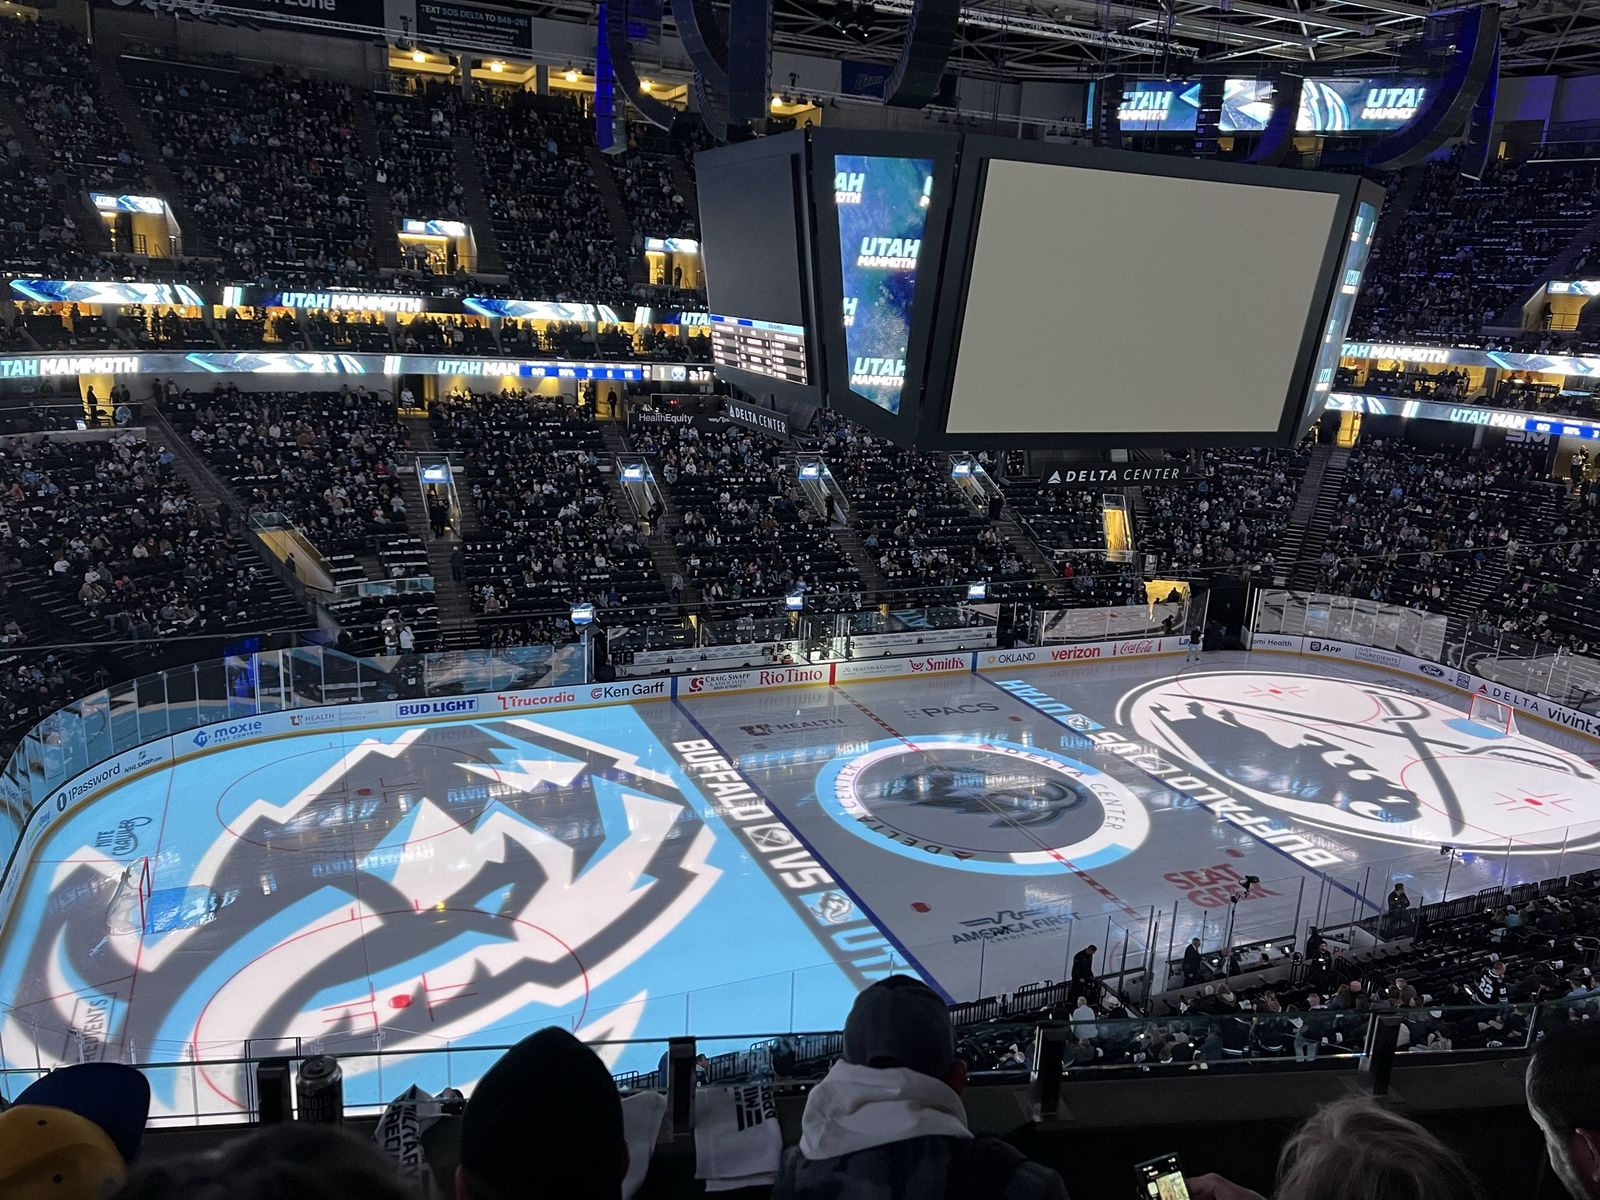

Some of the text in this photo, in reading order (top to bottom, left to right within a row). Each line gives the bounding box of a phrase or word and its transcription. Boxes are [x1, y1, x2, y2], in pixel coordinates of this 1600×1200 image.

[441, 7, 460, 17] SOS
[460, 9, 484, 21] DELTA
[484, 13, 496, 22] TO
[860, 236, 921, 258] UTAH
[857, 255, 917, 269] MAMMOTH
[281, 292, 422, 312] UTAH MAMMOTH
[680, 311, 711, 326] UTA
[1341, 344, 1449, 362] TAH MAMMOTH
[0, 356, 139, 377] TAH MAMMOTH
[437, 360, 482, 375] UTAH
[638, 413, 694, 424] HealthEquity
[735, 408, 787, 434] DELTA CENTER
[1450, 409, 1490, 424] UTAH
[1065, 468, 1180, 482] DELTA CENTER
[1268, 639, 1292, 648] Health
[998, 652, 1036, 663] OKLAND
[1052, 646, 1100, 660] verizon
[1358, 651, 1398, 663] INGREDIENTS
[926, 657, 964, 672] Smith's
[604, 682, 664, 698] Ken Garff
[994, 679, 1073, 715] UTAH
[510, 691, 575, 707] Trucordia
[1493, 687, 1539, 712] DELTA
[400, 700, 476, 716] BUD LIGHT
[920, 702, 1000, 717] PACS
[305, 713, 334, 721] HEALTH
[776, 719, 845, 730] HEALTH
[215, 721, 262, 738] moxie
[68, 763, 120, 800] 1Password
[673, 738, 775, 821] BUFFALO
[1089, 783, 1126, 833] CENTER
[1172, 776, 1344, 867] BUFFALO
[769, 851, 835, 889] VS
[1163, 863, 1246, 890] SEAT
[952, 911, 1081, 944] AMERCA FIRST
